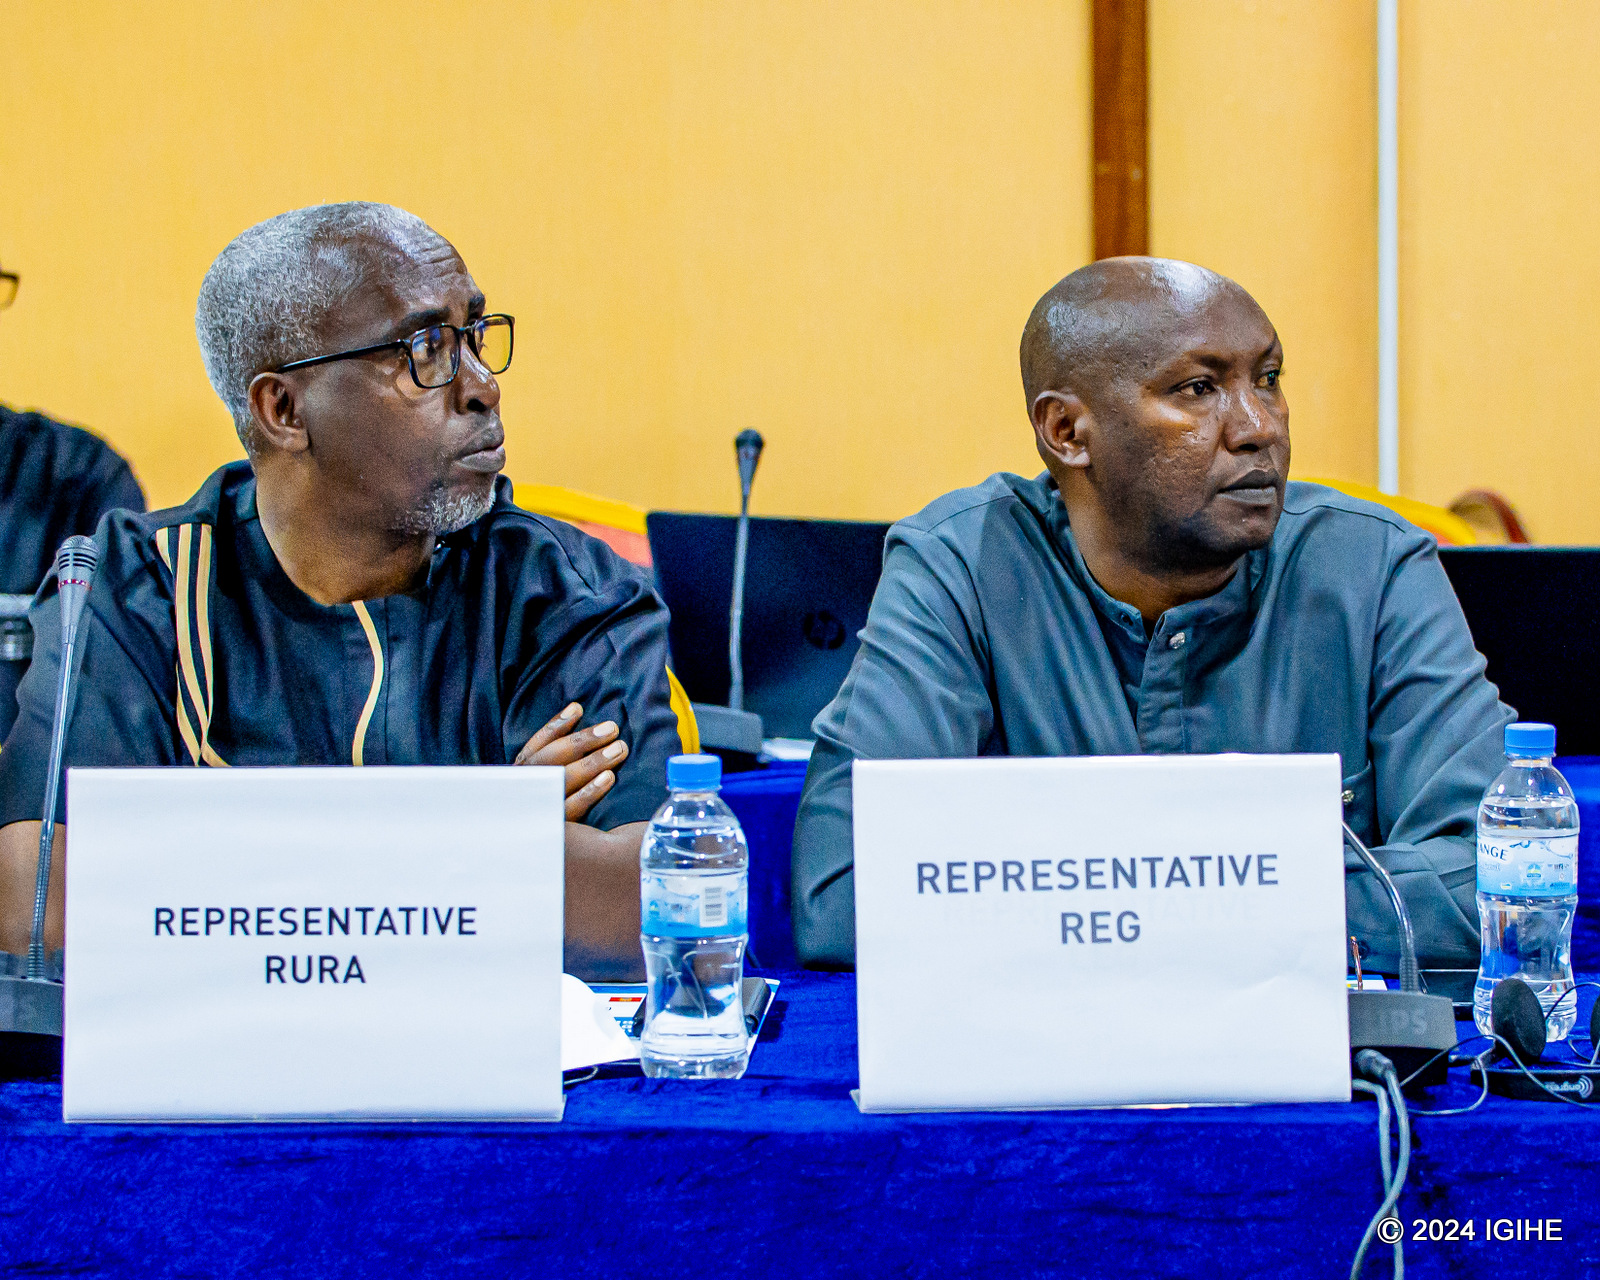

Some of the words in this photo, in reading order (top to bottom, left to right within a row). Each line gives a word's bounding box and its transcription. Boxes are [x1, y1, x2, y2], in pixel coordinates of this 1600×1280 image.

[916, 853, 1279, 895] REPRESENTATIVE
[154, 906, 478, 937] REPRESENTATIVE
[1060, 910, 1141, 945] REG
[265, 954, 367, 985] RURA
